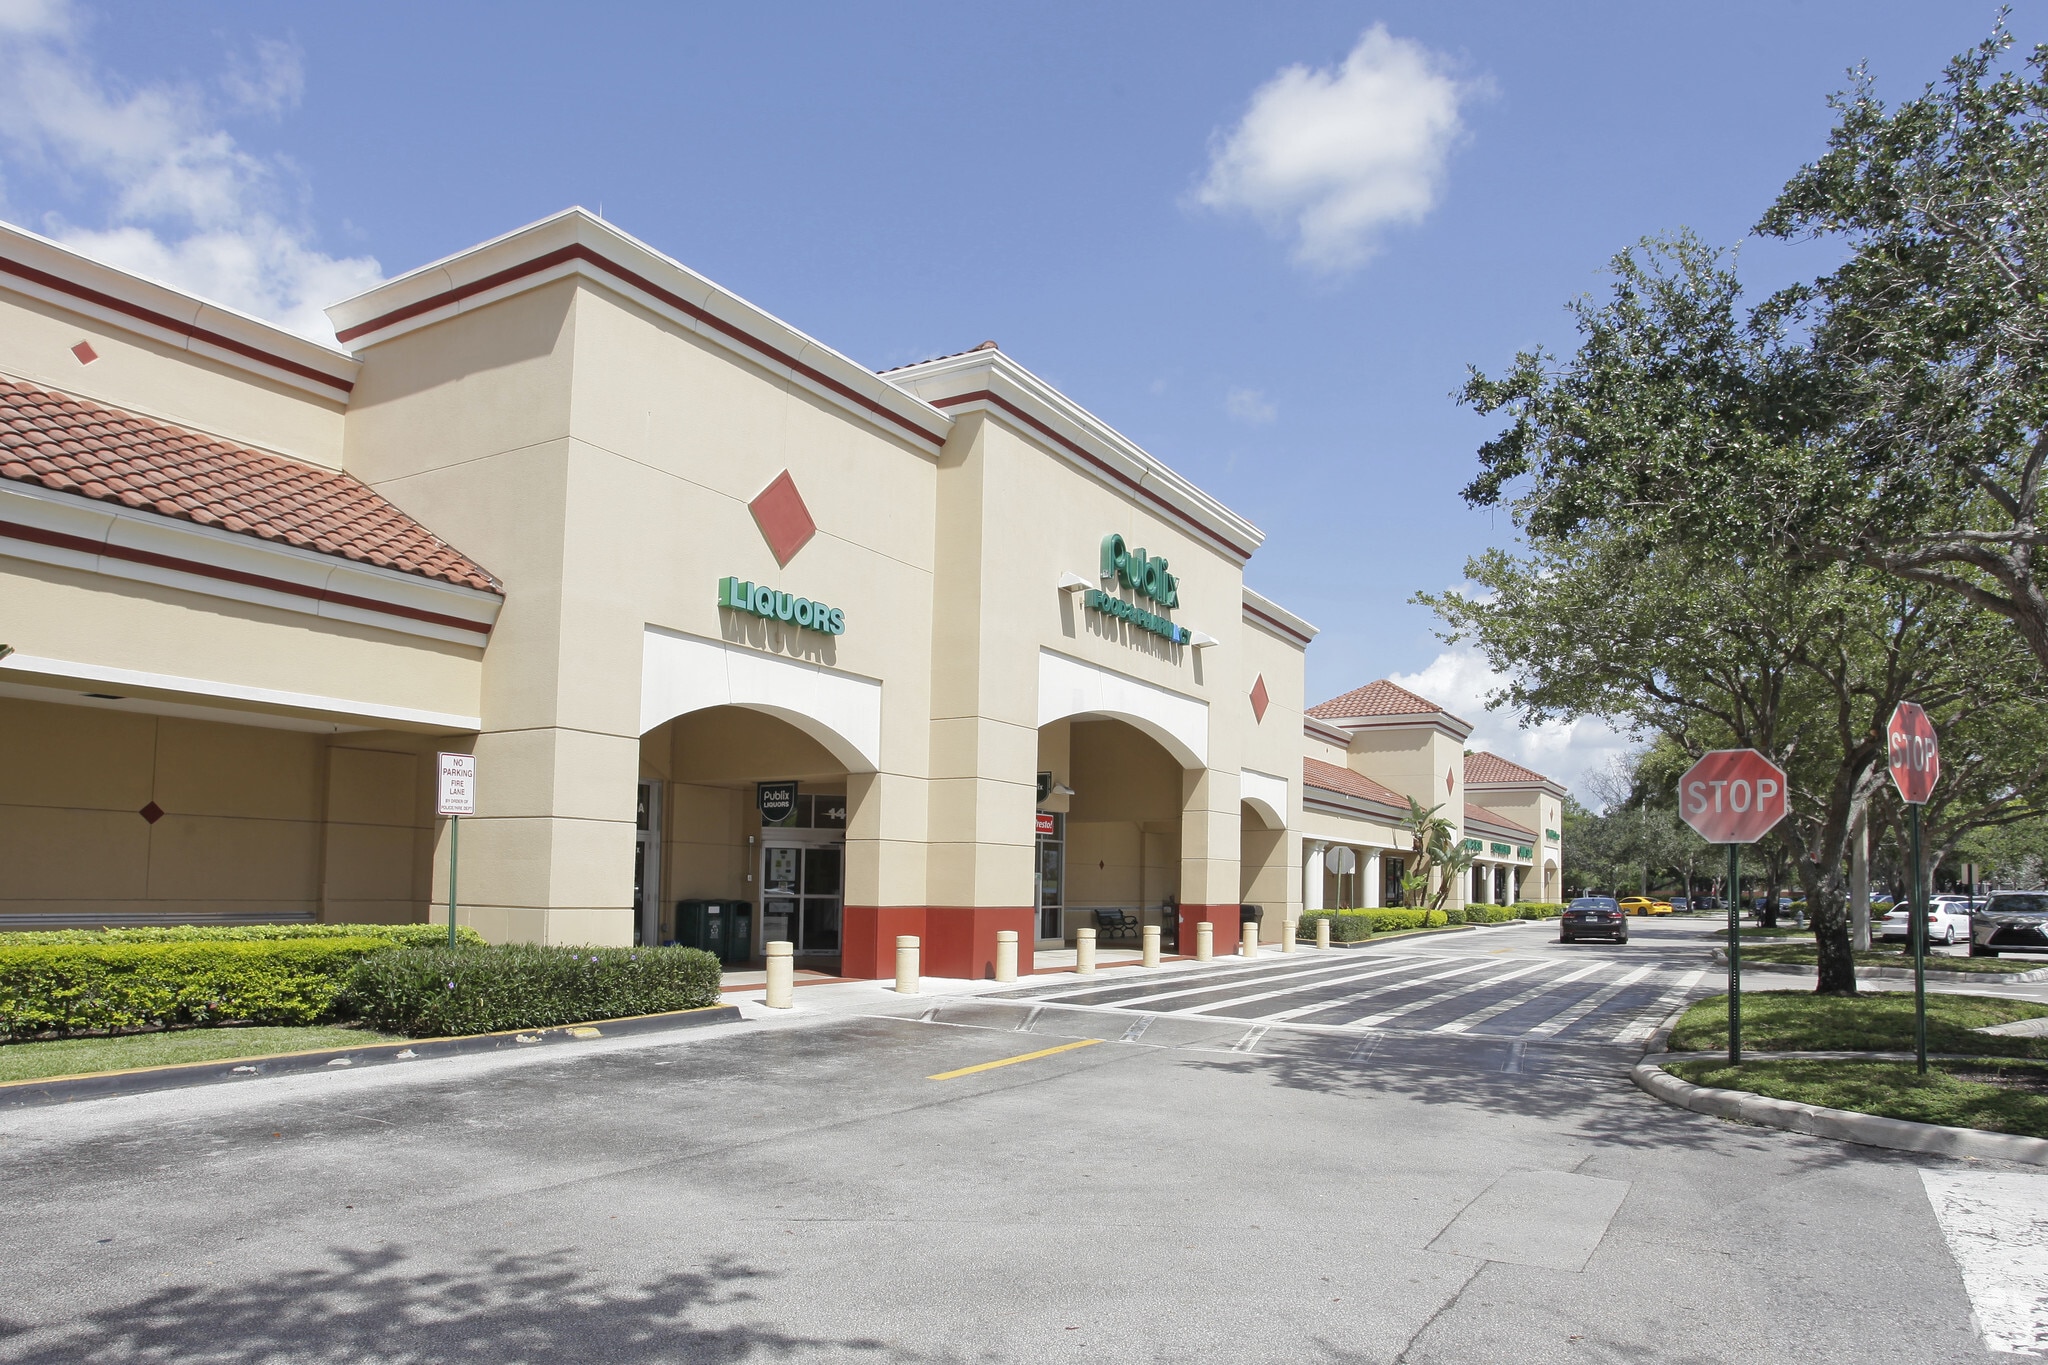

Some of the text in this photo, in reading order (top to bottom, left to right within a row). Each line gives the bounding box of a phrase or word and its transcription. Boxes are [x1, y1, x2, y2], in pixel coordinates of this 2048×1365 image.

[1100, 533, 1180, 609] Publix
[718, 576, 846, 635] LIQUORS
[1085, 589, 1127, 618] FOOD
[1891, 731, 1935, 773] STOP
[453, 758, 463, 767] NO
[442, 768, 473, 778] PARKING
[450, 779, 464, 788] FIRE
[449, 788, 465, 796] LANE
[763, 790, 790, 801] Publix
[1687, 778, 1778, 814] STOP
[1036, 820, 1053, 829] resto!
